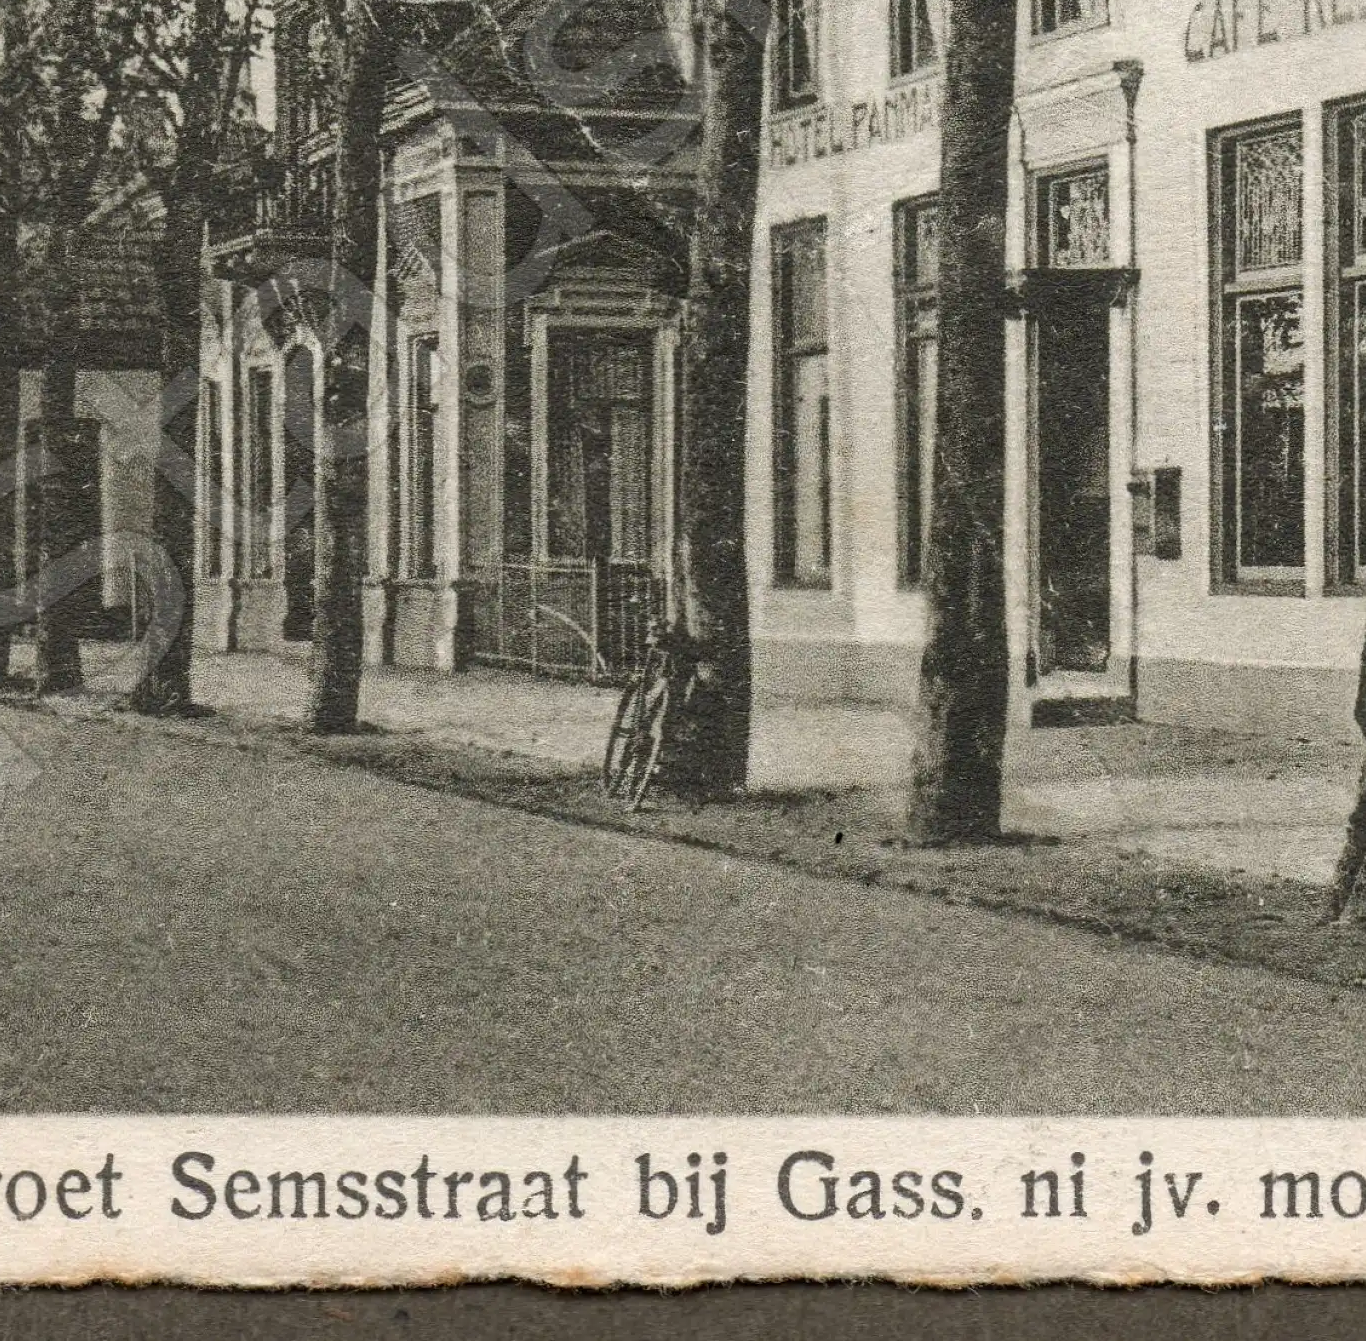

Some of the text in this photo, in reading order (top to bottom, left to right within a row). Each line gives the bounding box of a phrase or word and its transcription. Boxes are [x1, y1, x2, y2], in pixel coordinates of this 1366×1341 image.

[769, 85, 935, 169] HOTEL PANMA
[171, 1151, 588, 1221] Semsstraat
[635, 1151, 728, 1236] bij
[777, 1150, 983, 1221] Gass.
[1021, 1151, 1088, 1217] ni
[1131, 1150, 1220, 1236] jv.
